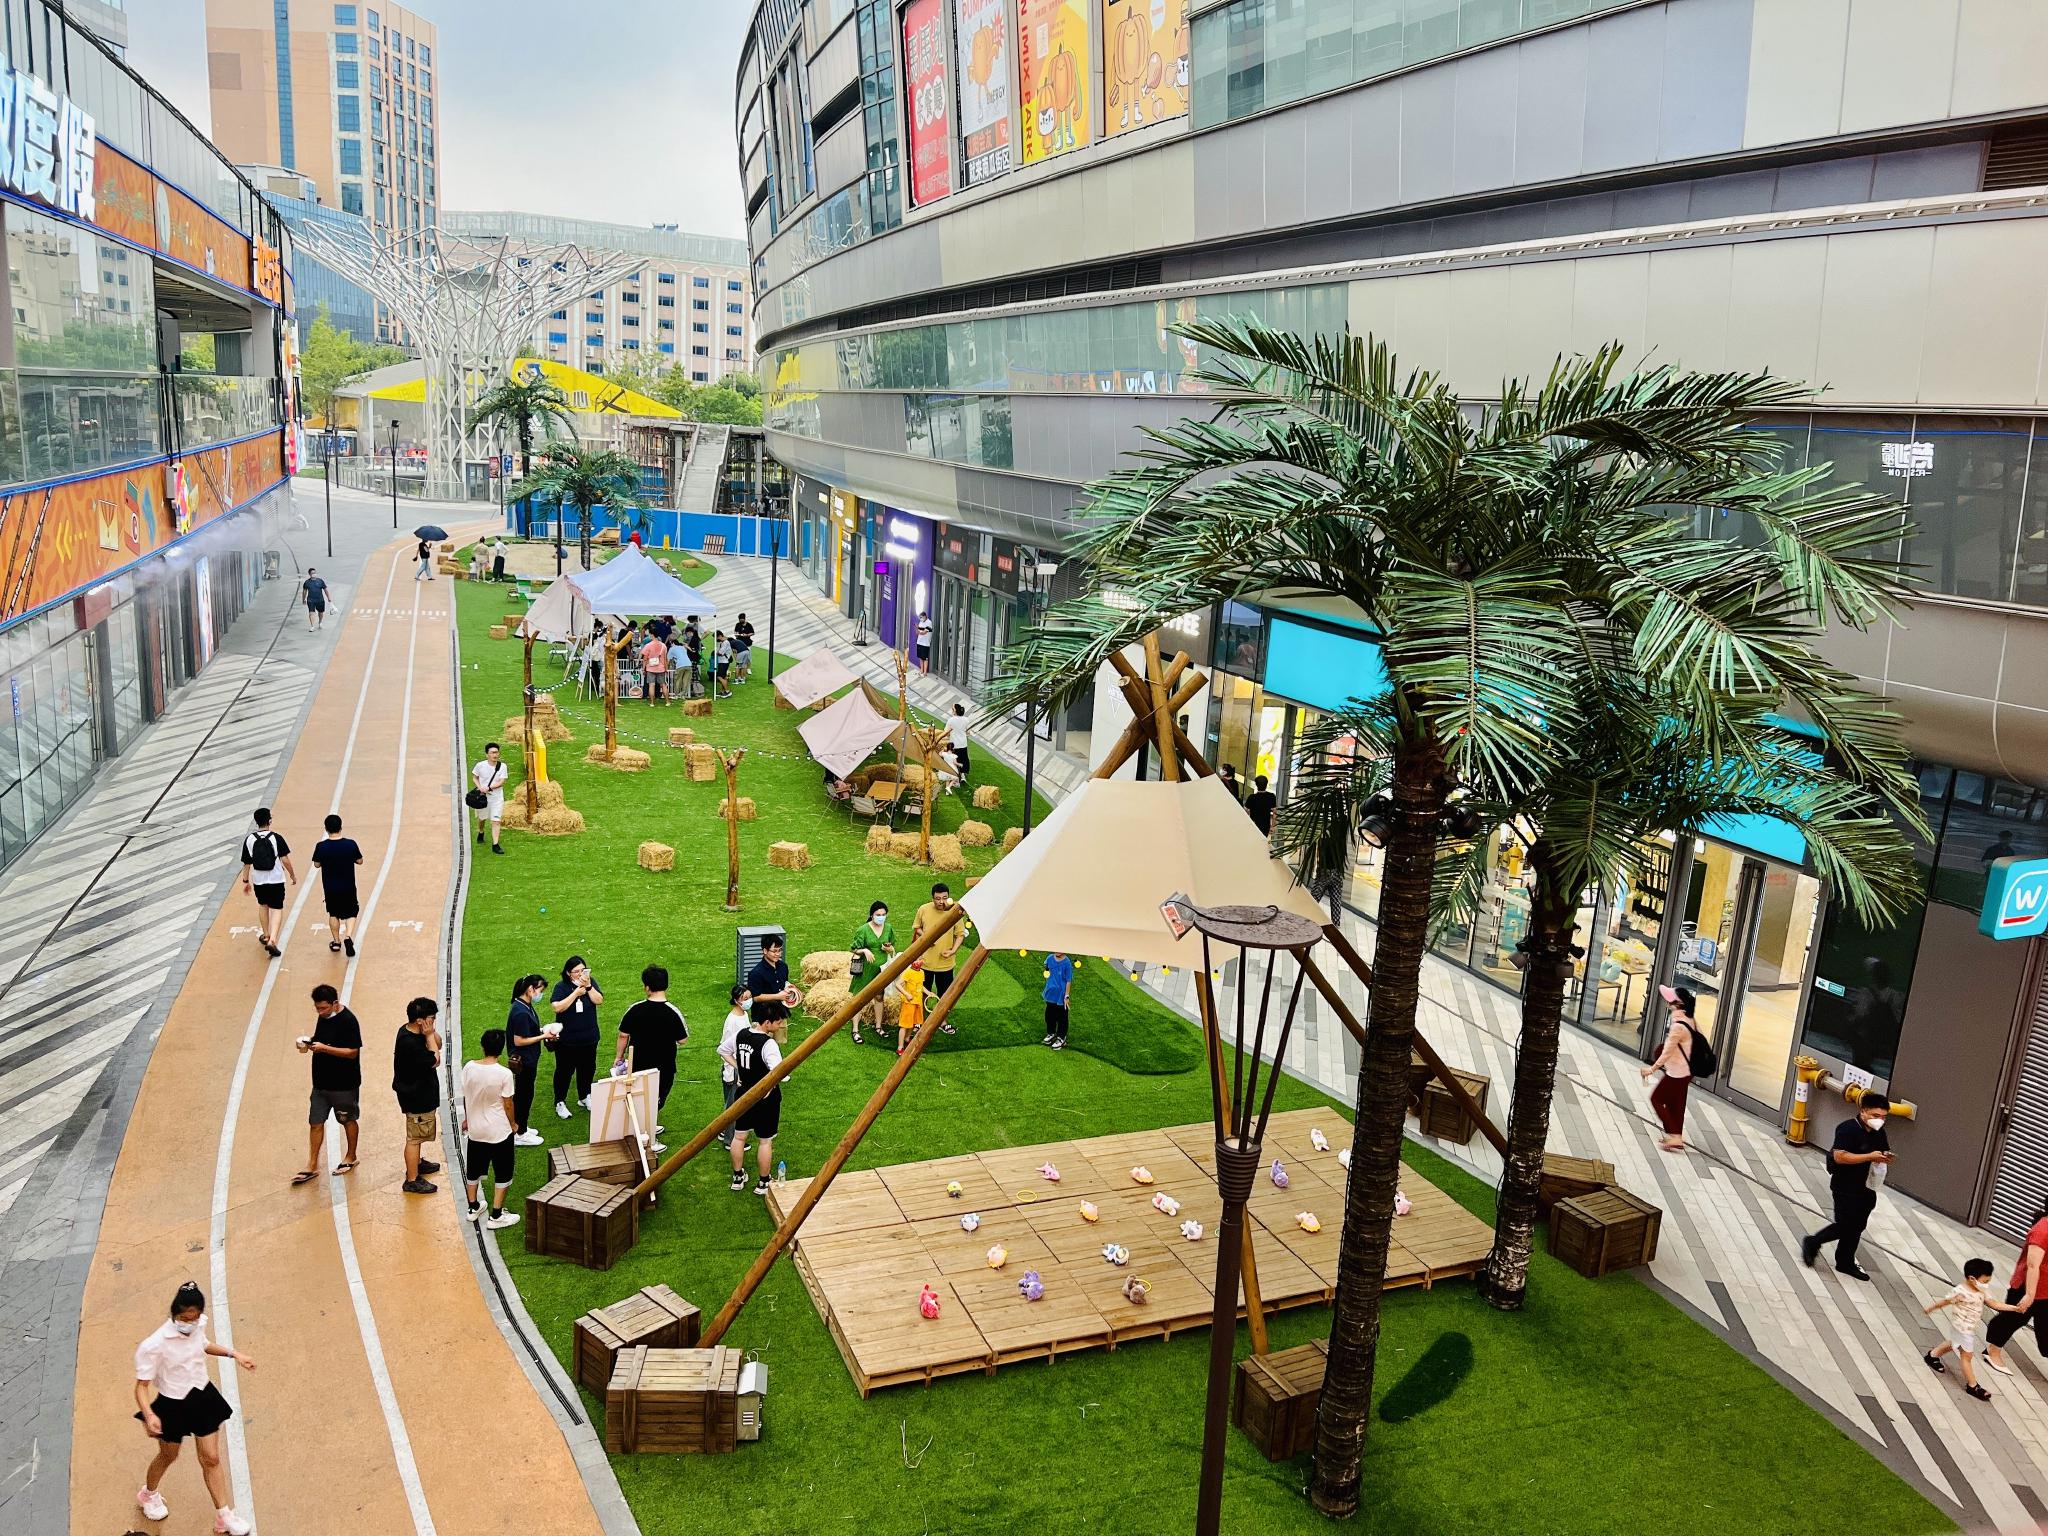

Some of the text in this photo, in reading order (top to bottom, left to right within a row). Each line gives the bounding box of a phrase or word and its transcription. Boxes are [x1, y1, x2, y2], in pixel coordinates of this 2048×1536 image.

[1021, 26, 1031, 81] IMIX
[0, 52, 97, 223] 度假
[1024, 92, 1034, 158] PARK
[2016, 885, 2042, 910] W
[739, 1050, 751, 1069] 11
